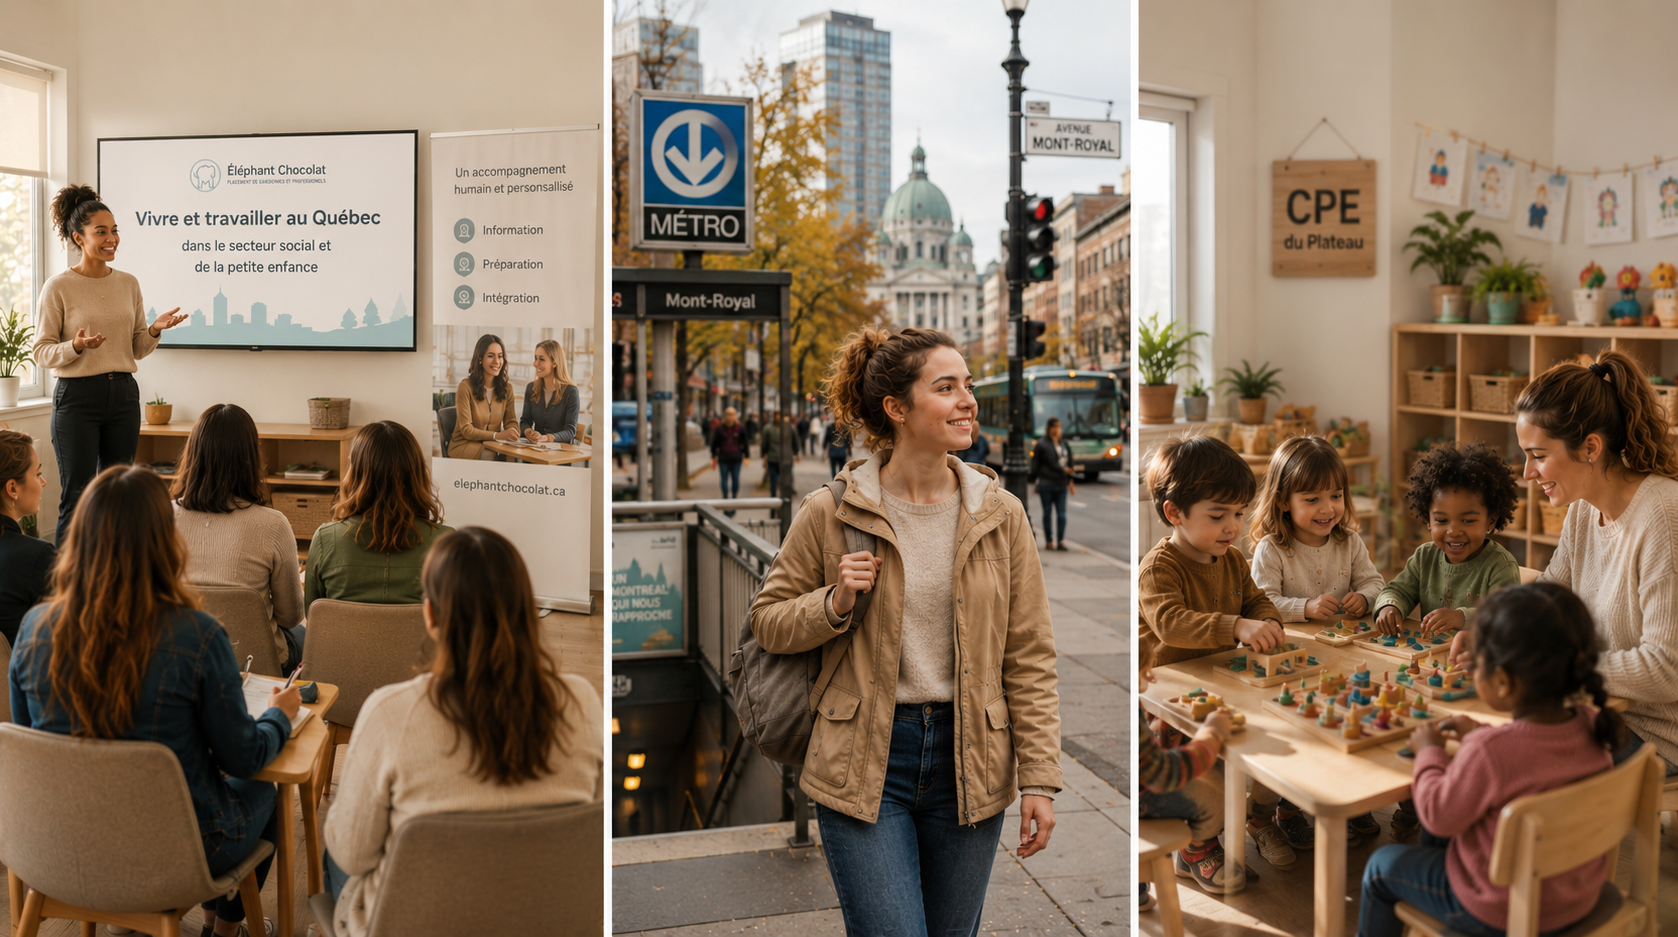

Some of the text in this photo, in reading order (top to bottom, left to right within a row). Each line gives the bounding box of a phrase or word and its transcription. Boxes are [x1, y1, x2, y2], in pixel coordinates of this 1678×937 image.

[1055, 123, 1092, 135] AVENUE
[1033, 137, 1115, 152] MONT-ROYAL
[228, 163, 326, 178] Éléphant Chocolat
[456, 164, 566, 178] Un accompagnement
[454, 184, 491, 194] humain
[494, 184, 504, 193] et
[1286, 189, 1360, 225] CPE
[135, 209, 381, 226] Vivre et travailler au Québec
[651, 209, 740, 238] MÉTRO
[483, 224, 544, 235] Information
[181, 239, 331, 251] dans le secteur social et
[1284, 234, 1364, 250] du Plateau
[194, 261, 318, 275] de la petite enfance
[483, 258, 544, 271] Préparation
[483, 292, 540, 305] Intégration
[665, 293, 756, 311] Mont-Royal
[453, 478, 566, 496] elephantchocolat.ca
[612, 573, 627, 584] UN
[612, 597, 661, 610] QUI NOUS
[612, 609, 672, 622] RAPPROCHE
